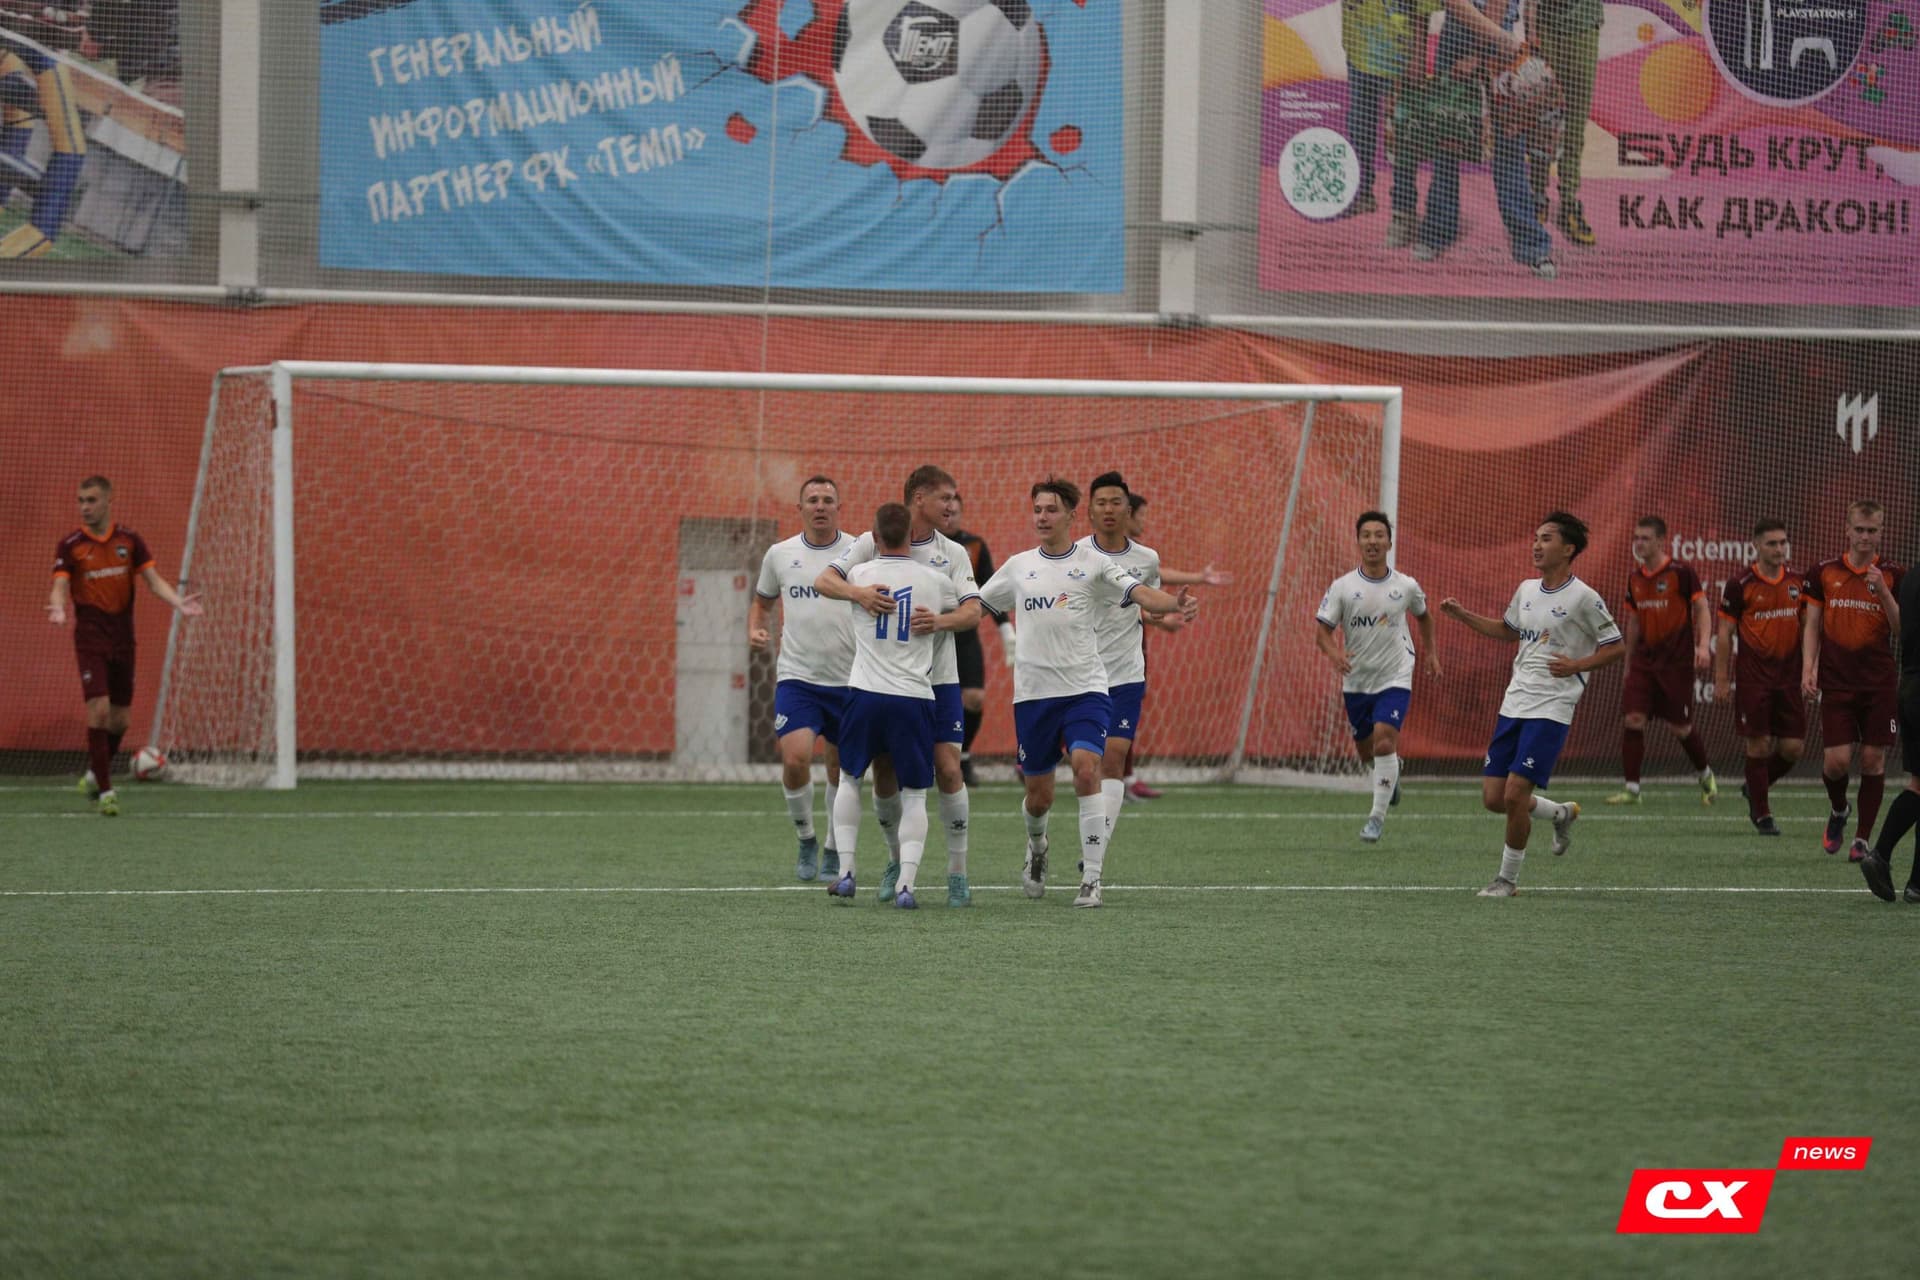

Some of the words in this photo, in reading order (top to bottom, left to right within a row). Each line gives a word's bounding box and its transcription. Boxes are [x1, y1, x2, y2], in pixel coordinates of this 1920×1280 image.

[1777, 8, 1845, 19] PLAYSTATION
[368, 2, 602, 87] ГЕНЕРАЛЬНЫЙ
[368, 52, 686, 159] ИНФОРМАЦИОННЫЙ
[367, 159, 513, 224] ПАРТНЕР
[522, 145, 579, 192] ФК
[587, 123, 706, 177] «ТЕМП»
[1617, 131, 1755, 176] БУДЬ
[1767, 136, 1885, 180] КРУТ,
[1618, 194, 1704, 230] КАК
[1716, 197, 1911, 239] ДРАКОН!
[876, 586, 912, 643] 11
[1024, 597, 1056, 611] GNV
[1890, 719, 1897, 733] 6
